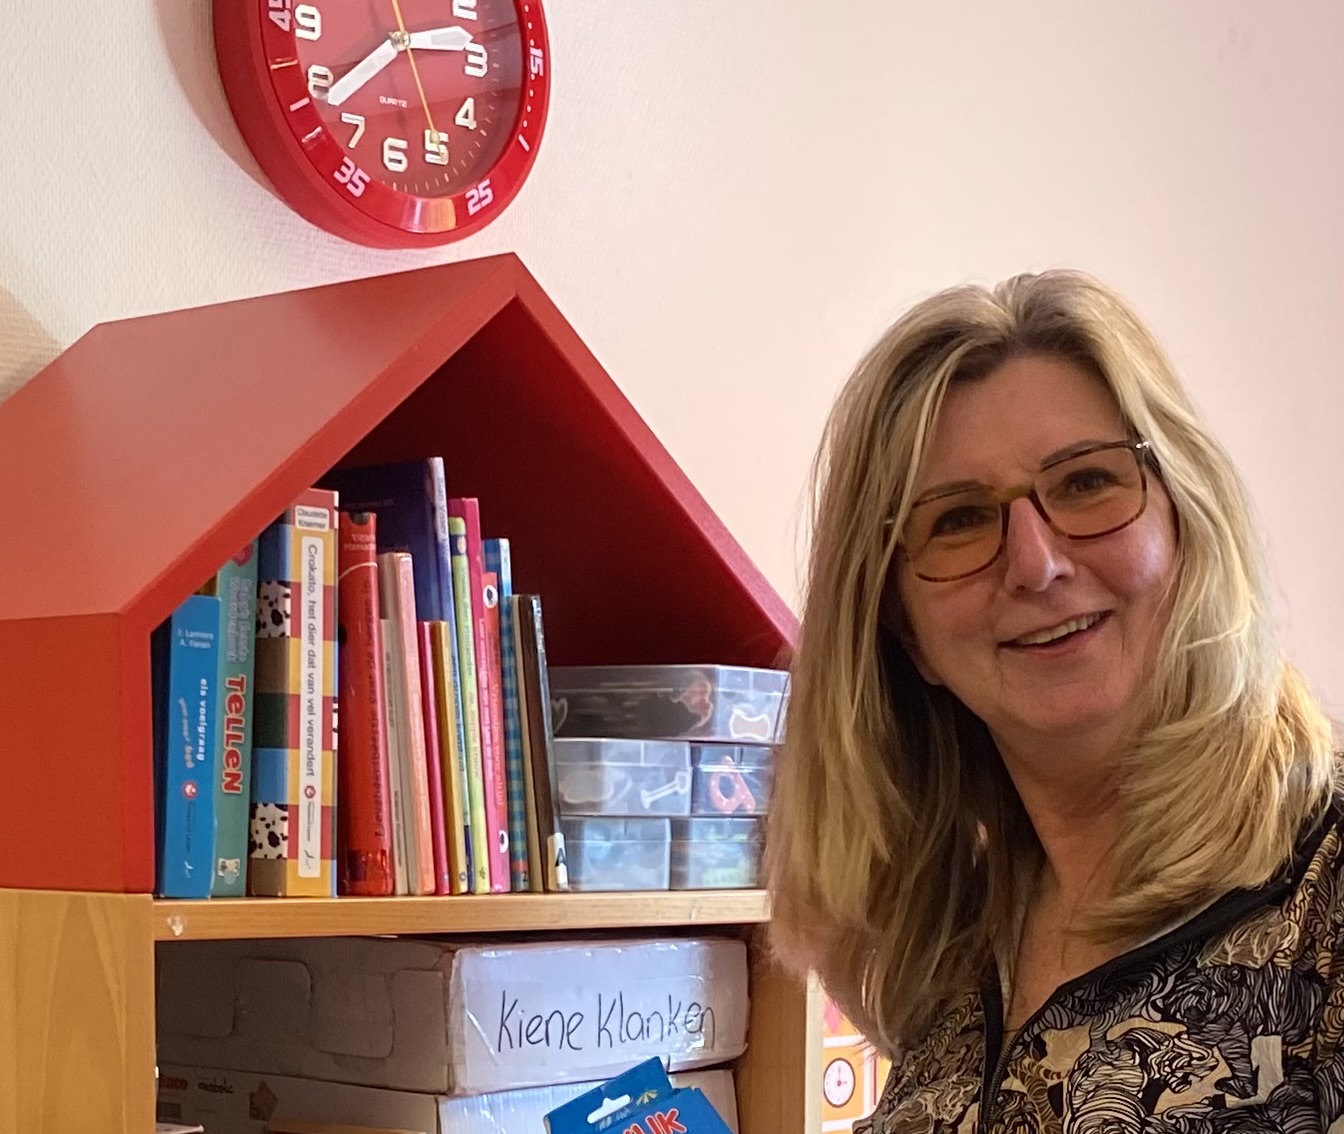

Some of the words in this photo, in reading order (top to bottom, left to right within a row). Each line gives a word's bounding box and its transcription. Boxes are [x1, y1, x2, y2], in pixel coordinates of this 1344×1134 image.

[295, 4, 322, 41] 9
[464, 43, 488, 78] 3
[530, 47, 544, 77] 15
[308, 64, 334, 99] 8
[341, 112, 366, 149] 7
[455, 98, 476, 130] 4
[383, 137, 408, 172] 6
[424, 130, 449, 165] 5
[333, 157, 371, 198] 35
[465, 179, 494, 216] 25
[306, 543, 318, 596] Crokato,
[307, 600, 318, 620] het
[307, 622, 318, 646] dier
[307, 649, 318, 669] dat
[306, 672, 316, 694] van
[305, 719, 317, 776] verandert
[497, 989, 584, 1052] Kiene
[597, 990, 715, 1051] Klanken
